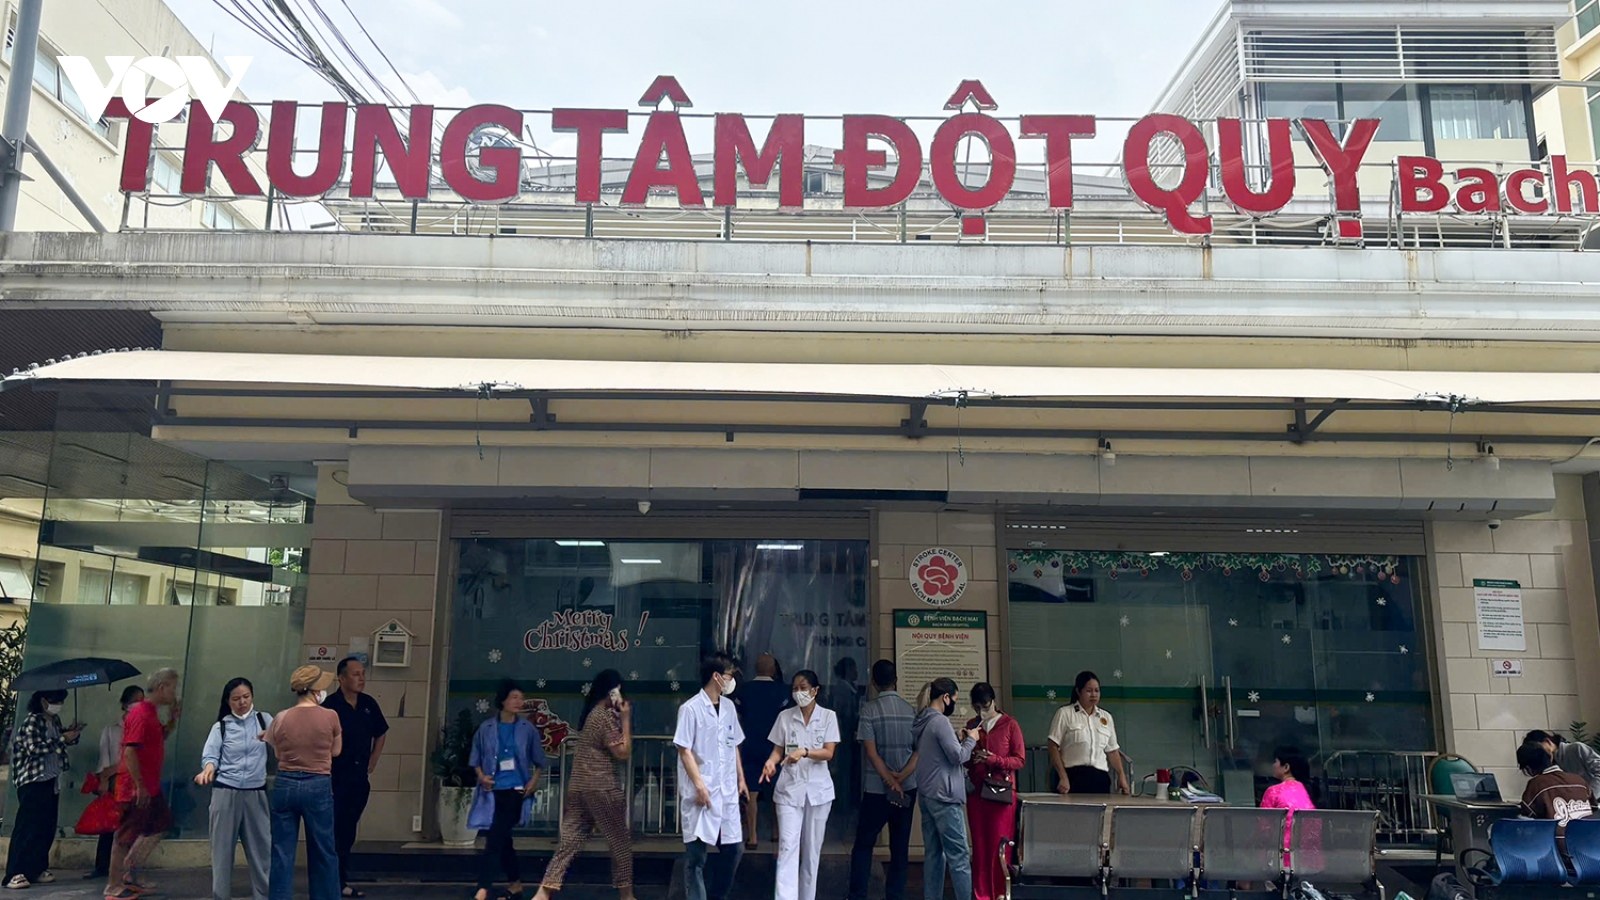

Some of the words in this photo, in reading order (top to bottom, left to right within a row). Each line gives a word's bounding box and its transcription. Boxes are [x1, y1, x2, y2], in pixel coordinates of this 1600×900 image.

[105, 97, 524, 201] TRUNG
[552, 75, 804, 211] TÂM
[834, 79, 1095, 240] ĐỘT
[1123, 114, 1382, 240] QUỴ
[1396, 154, 1600, 213] Bach
[913, 549, 937, 567] STROKE
[938, 549, 963, 568] CENTER
[940, 582, 966, 605] HOSPITAL
[549, 609, 613, 634] Merry
[912, 632, 922, 640] NỘI
[938, 632, 955, 640] BỆNH
